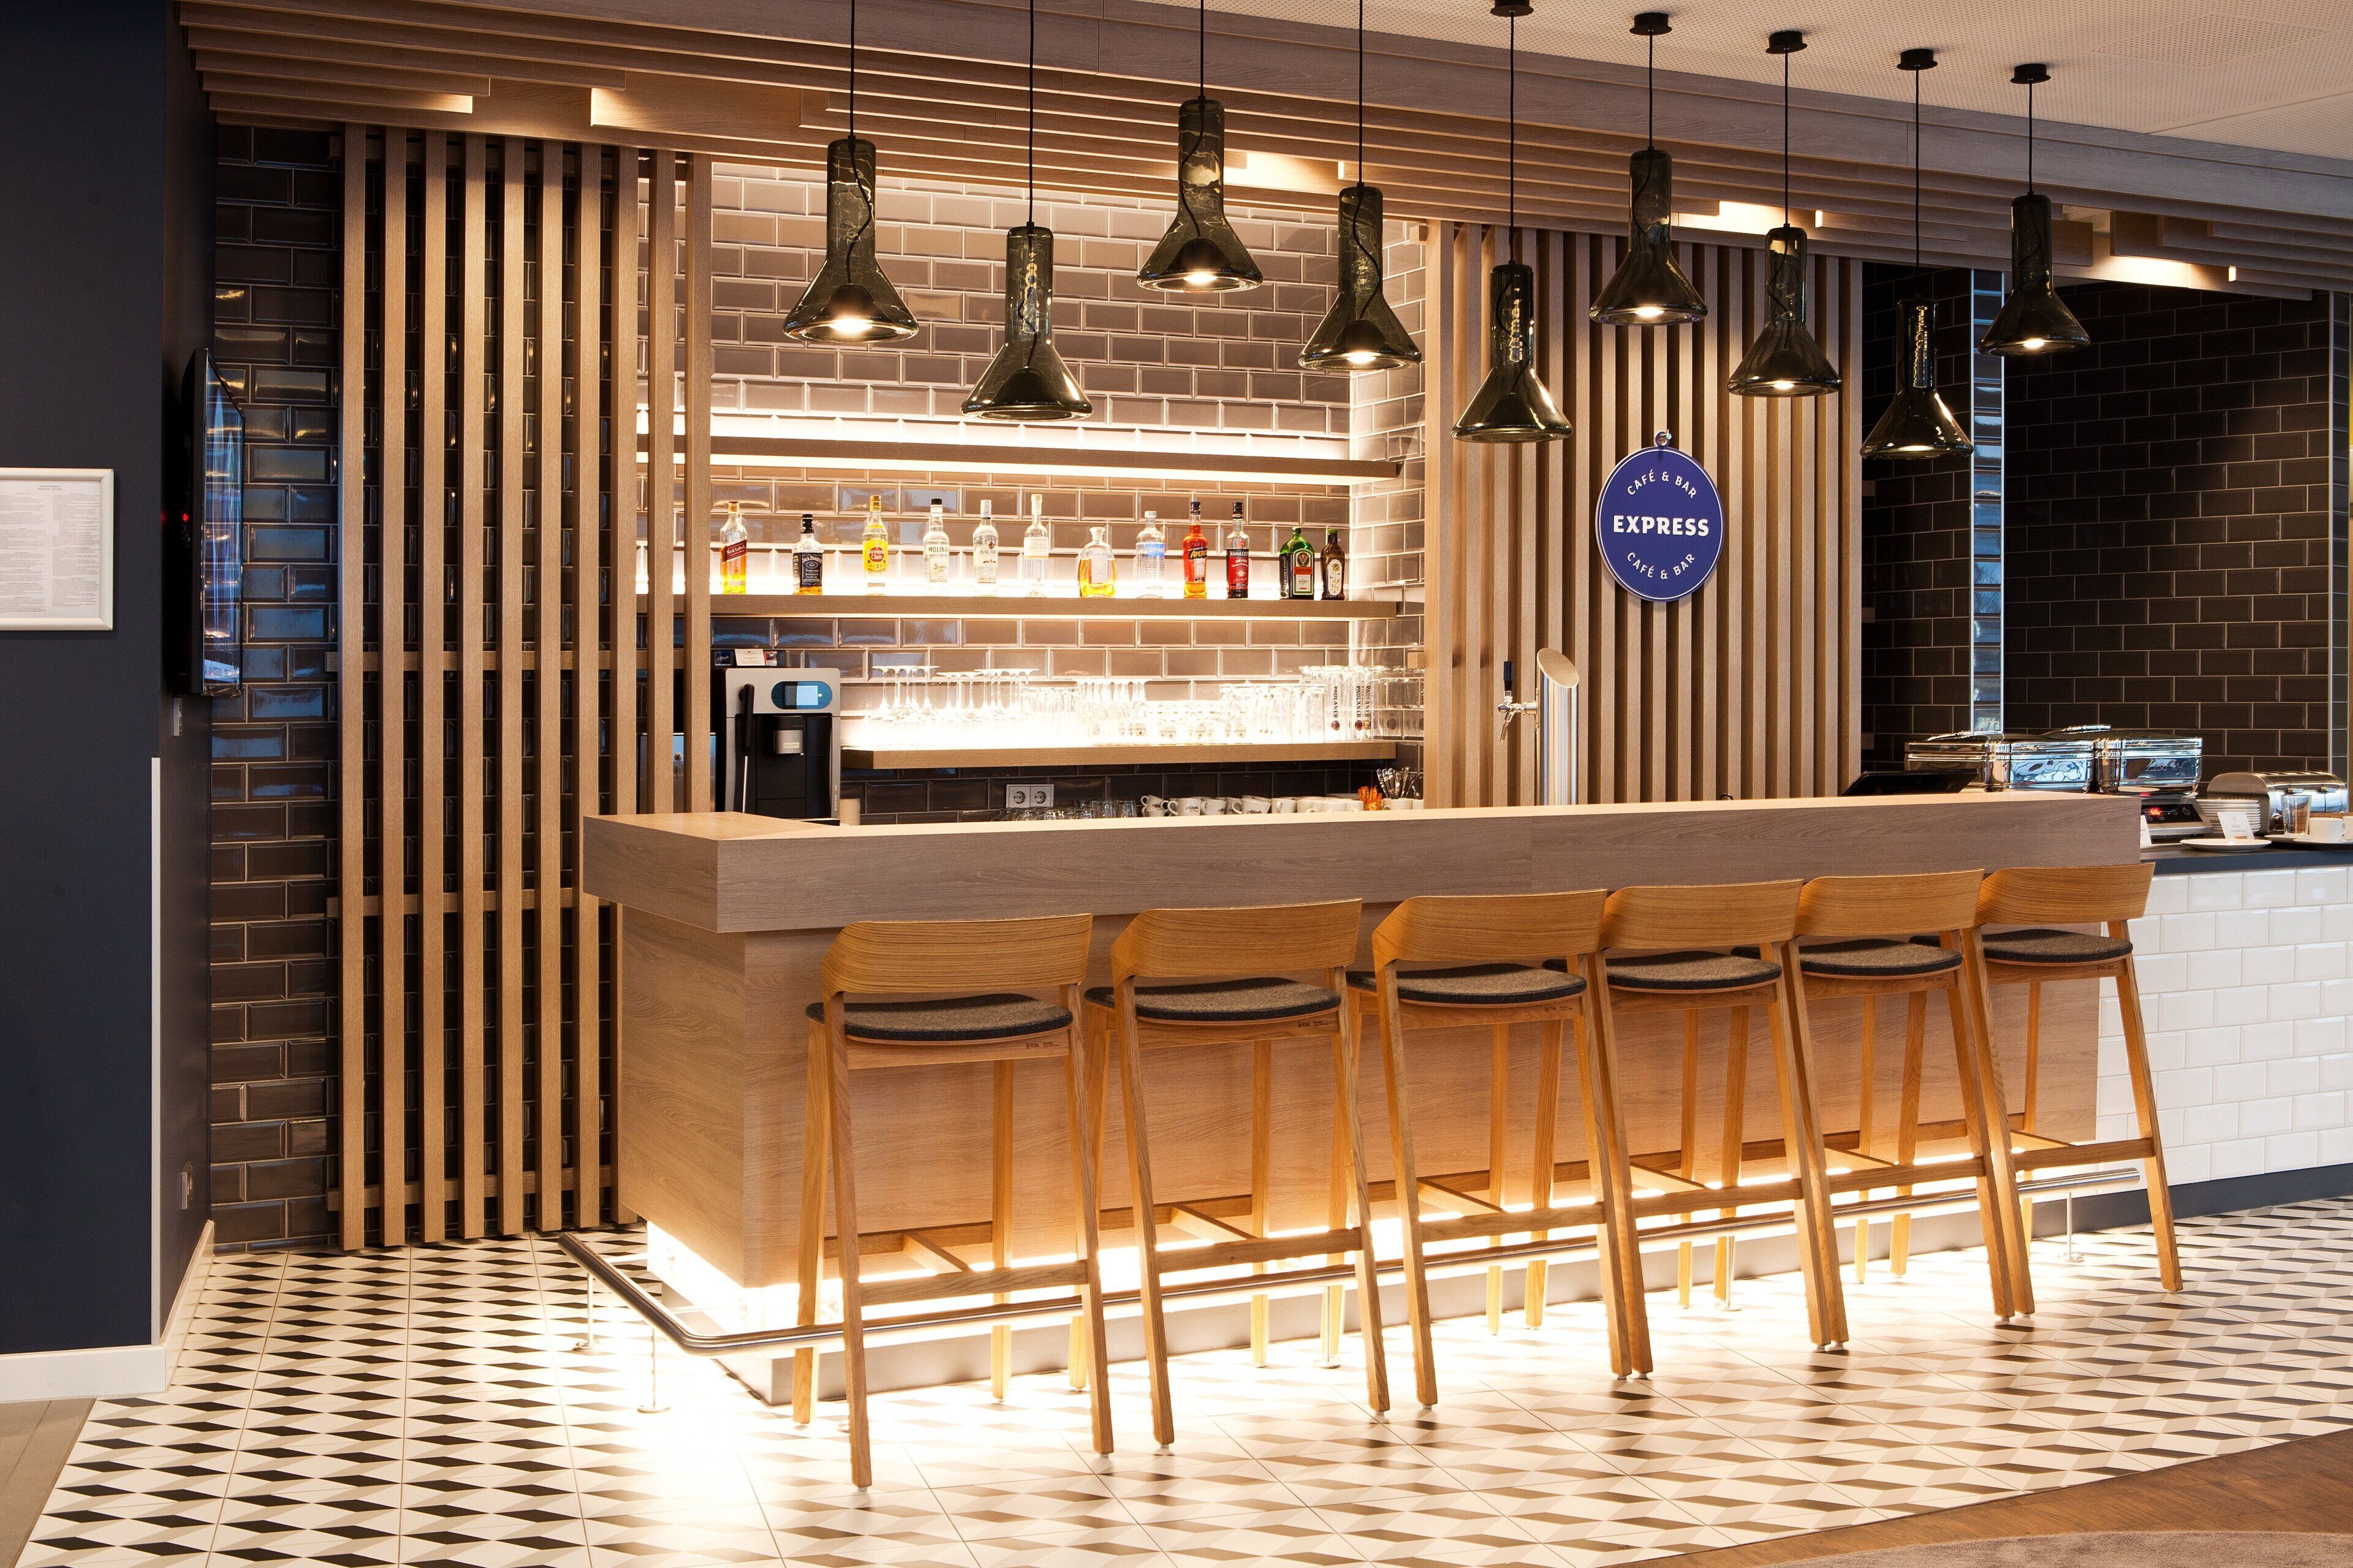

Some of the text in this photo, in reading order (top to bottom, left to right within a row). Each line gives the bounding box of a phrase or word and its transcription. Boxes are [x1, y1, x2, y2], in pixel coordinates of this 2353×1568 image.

[1627, 469, 1697, 498] CAFÉ & BAR
[1613, 515, 1709, 537] EXPRESS
[1627, 552, 1696, 580] CAFÉ & BAR
